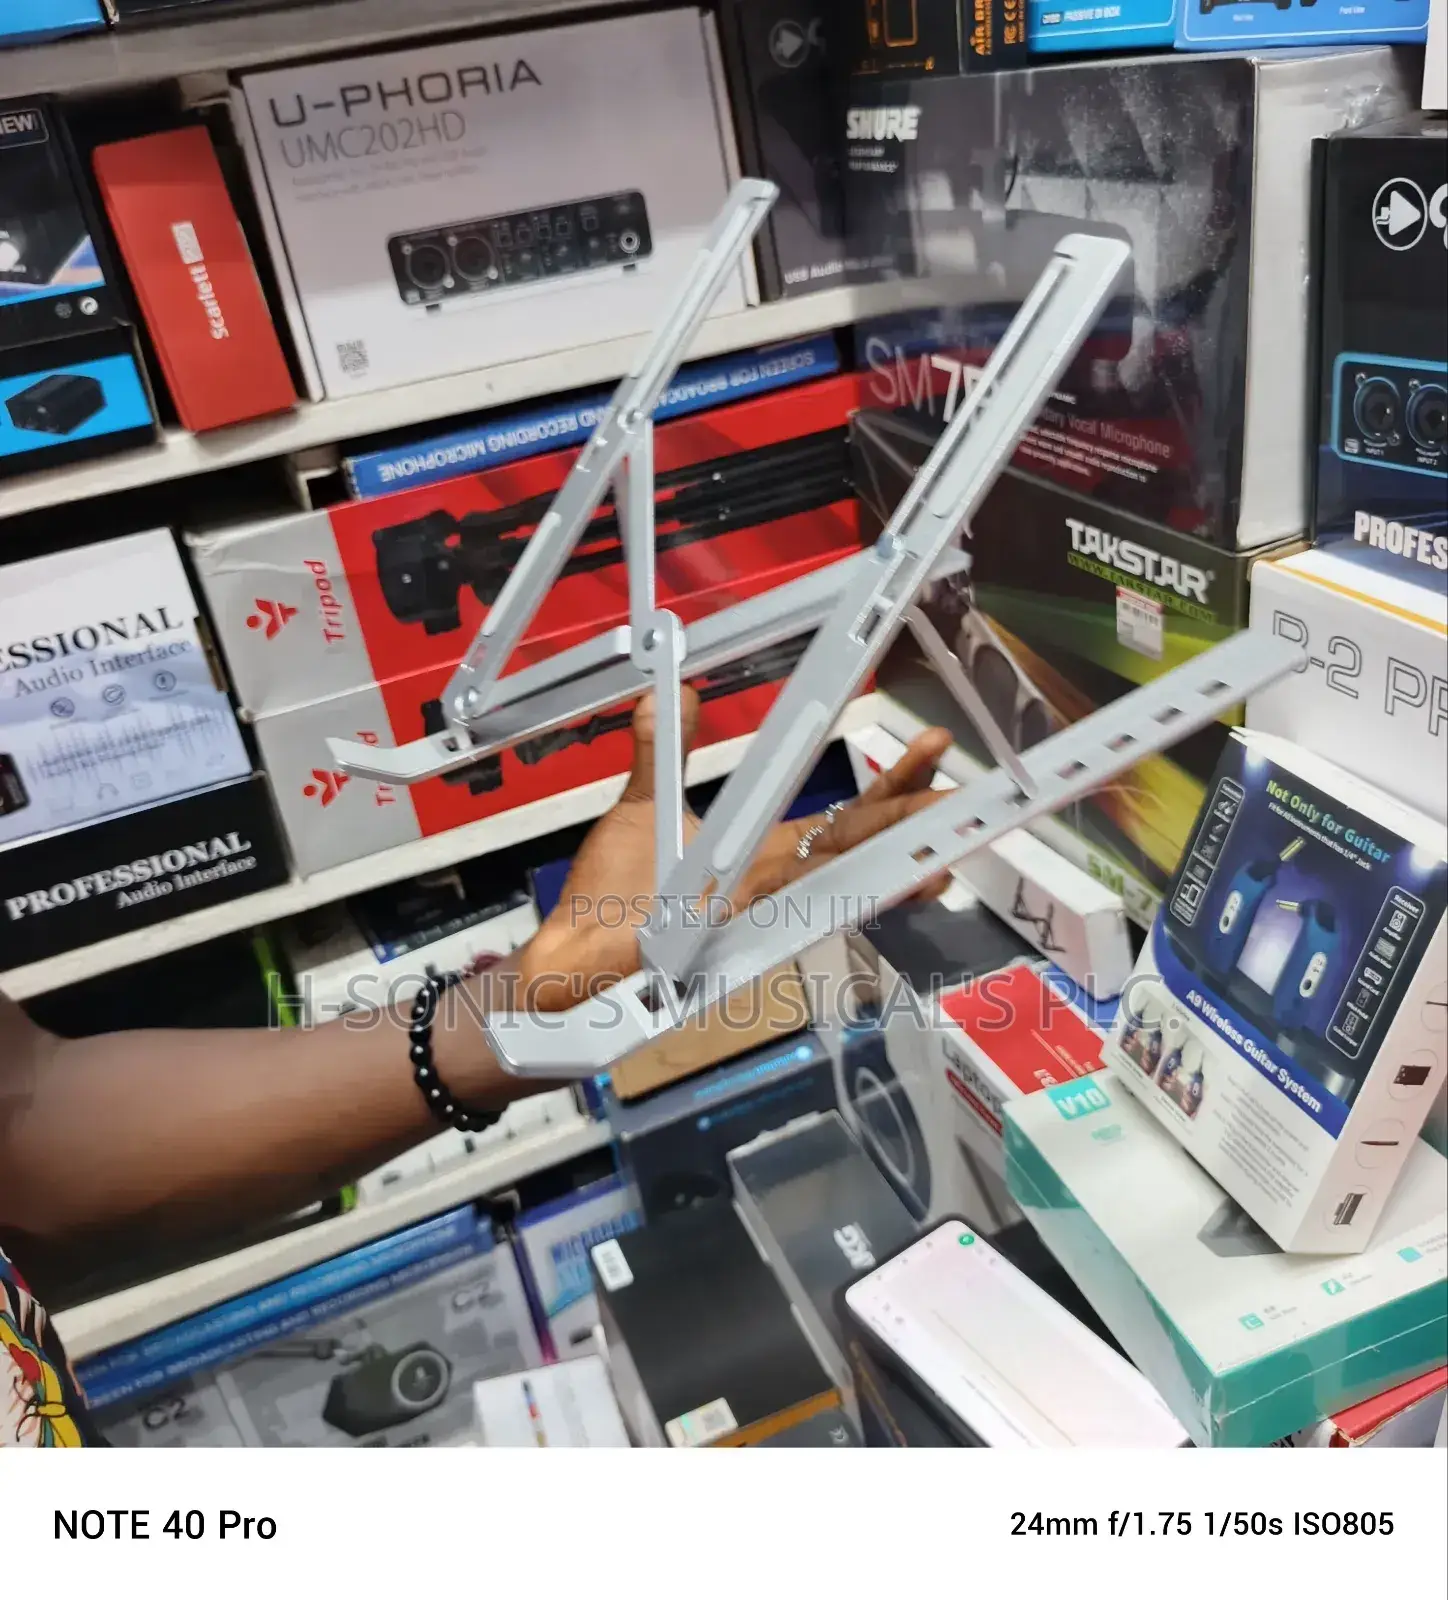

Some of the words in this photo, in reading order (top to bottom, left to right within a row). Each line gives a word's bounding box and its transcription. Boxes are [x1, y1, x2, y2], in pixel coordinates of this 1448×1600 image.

[269, 58, 543, 128] U-PHORIA
[280, 111, 467, 168] UMC202HD
[847, 105, 922, 142] SHURE
[488, 410, 580, 454] RECORDING
[1067, 412, 1097, 436] Vocal
[1100, 421, 1171, 459] Microphone
[379, 437, 487, 483] MICROPHONE
[1065, 517, 1208, 605] TAKSTAR
[304, 559, 344, 644] Tripod
[14, 664, 84, 699] Audio
[90, 638, 191, 673] Interface
[1266, 779, 1290, 804] Not
[1289, 794, 1321, 824] Only
[1321, 813, 1344, 835] for
[1344, 828, 1392, 864] Guitar
[6, 831, 253, 920] PROFESSIONAL
[116, 876, 172, 909] Audio
[171, 855, 258, 892] Interface
[1393, 894, 1419, 914] Receiver
[1186, 989, 1203, 1007] A9
[1201, 1000, 1244, 1046] Wireless
[1243, 1038, 1279, 1074] Guitar
[1277, 1067, 1322, 1113] System
[833, 1222, 877, 1269] AKG
[451, 1283, 491, 1314] C2
[142, 1399, 188, 1430] C2
